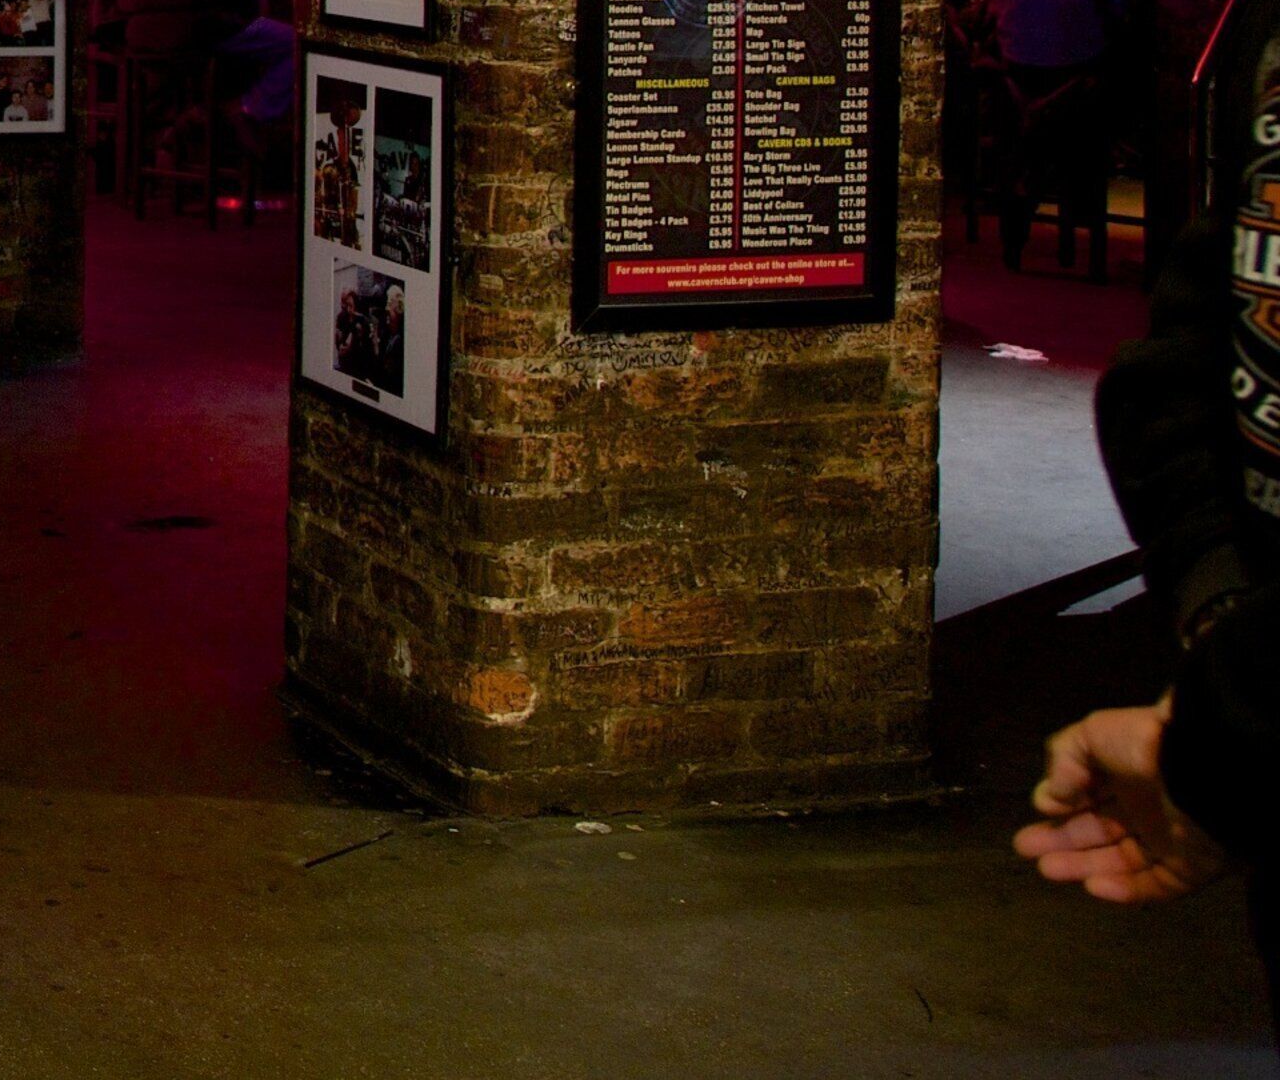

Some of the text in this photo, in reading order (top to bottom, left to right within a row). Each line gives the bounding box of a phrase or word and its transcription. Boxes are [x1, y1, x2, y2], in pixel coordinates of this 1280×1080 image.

[745, 40, 770, 51] Large
[608, 55, 647, 66] Lanyards
[607, 67, 643, 77] Patches
[766, 64, 788, 74] Pack
[635, 78, 710, 89] MISCELLANEOUS
[775, 75, 836, 86] CAVERN BAGS
[607, 92, 641, 102] Coaster
[744, 102, 782, 112] Shoulder
[607, 118, 639, 129] Jigsaw
[660, 129, 687, 139] Cards
[744, 127, 778, 138] Bowling
[639, 142, 675, 153] Standup
[757, 138, 792, 149] CAVERN
[633, 153, 702, 165] Lennon Standup
[765, 151, 791, 161] Storm
[743, 163, 801, 173] The Three
[606, 180, 650, 190] Plectrums
[743, 174, 843, 186] Love That Really Counts
[743, 188, 784, 200] Liddypool
[621, 205, 653, 216] Badges
[775, 200, 805, 210] Cellars
[621, 217, 653, 228] Badges
[763, 212, 813, 223] Anniversary
[742, 224, 830, 236] Music The Thing
[605, 231, 622, 242] Key
[604, 243, 654, 253] Drumsticks
[616, 259, 837, 275] For more souvenirs please check out the store
[667, 273, 805, 289] www.cavernclub.org/cavern-shop
